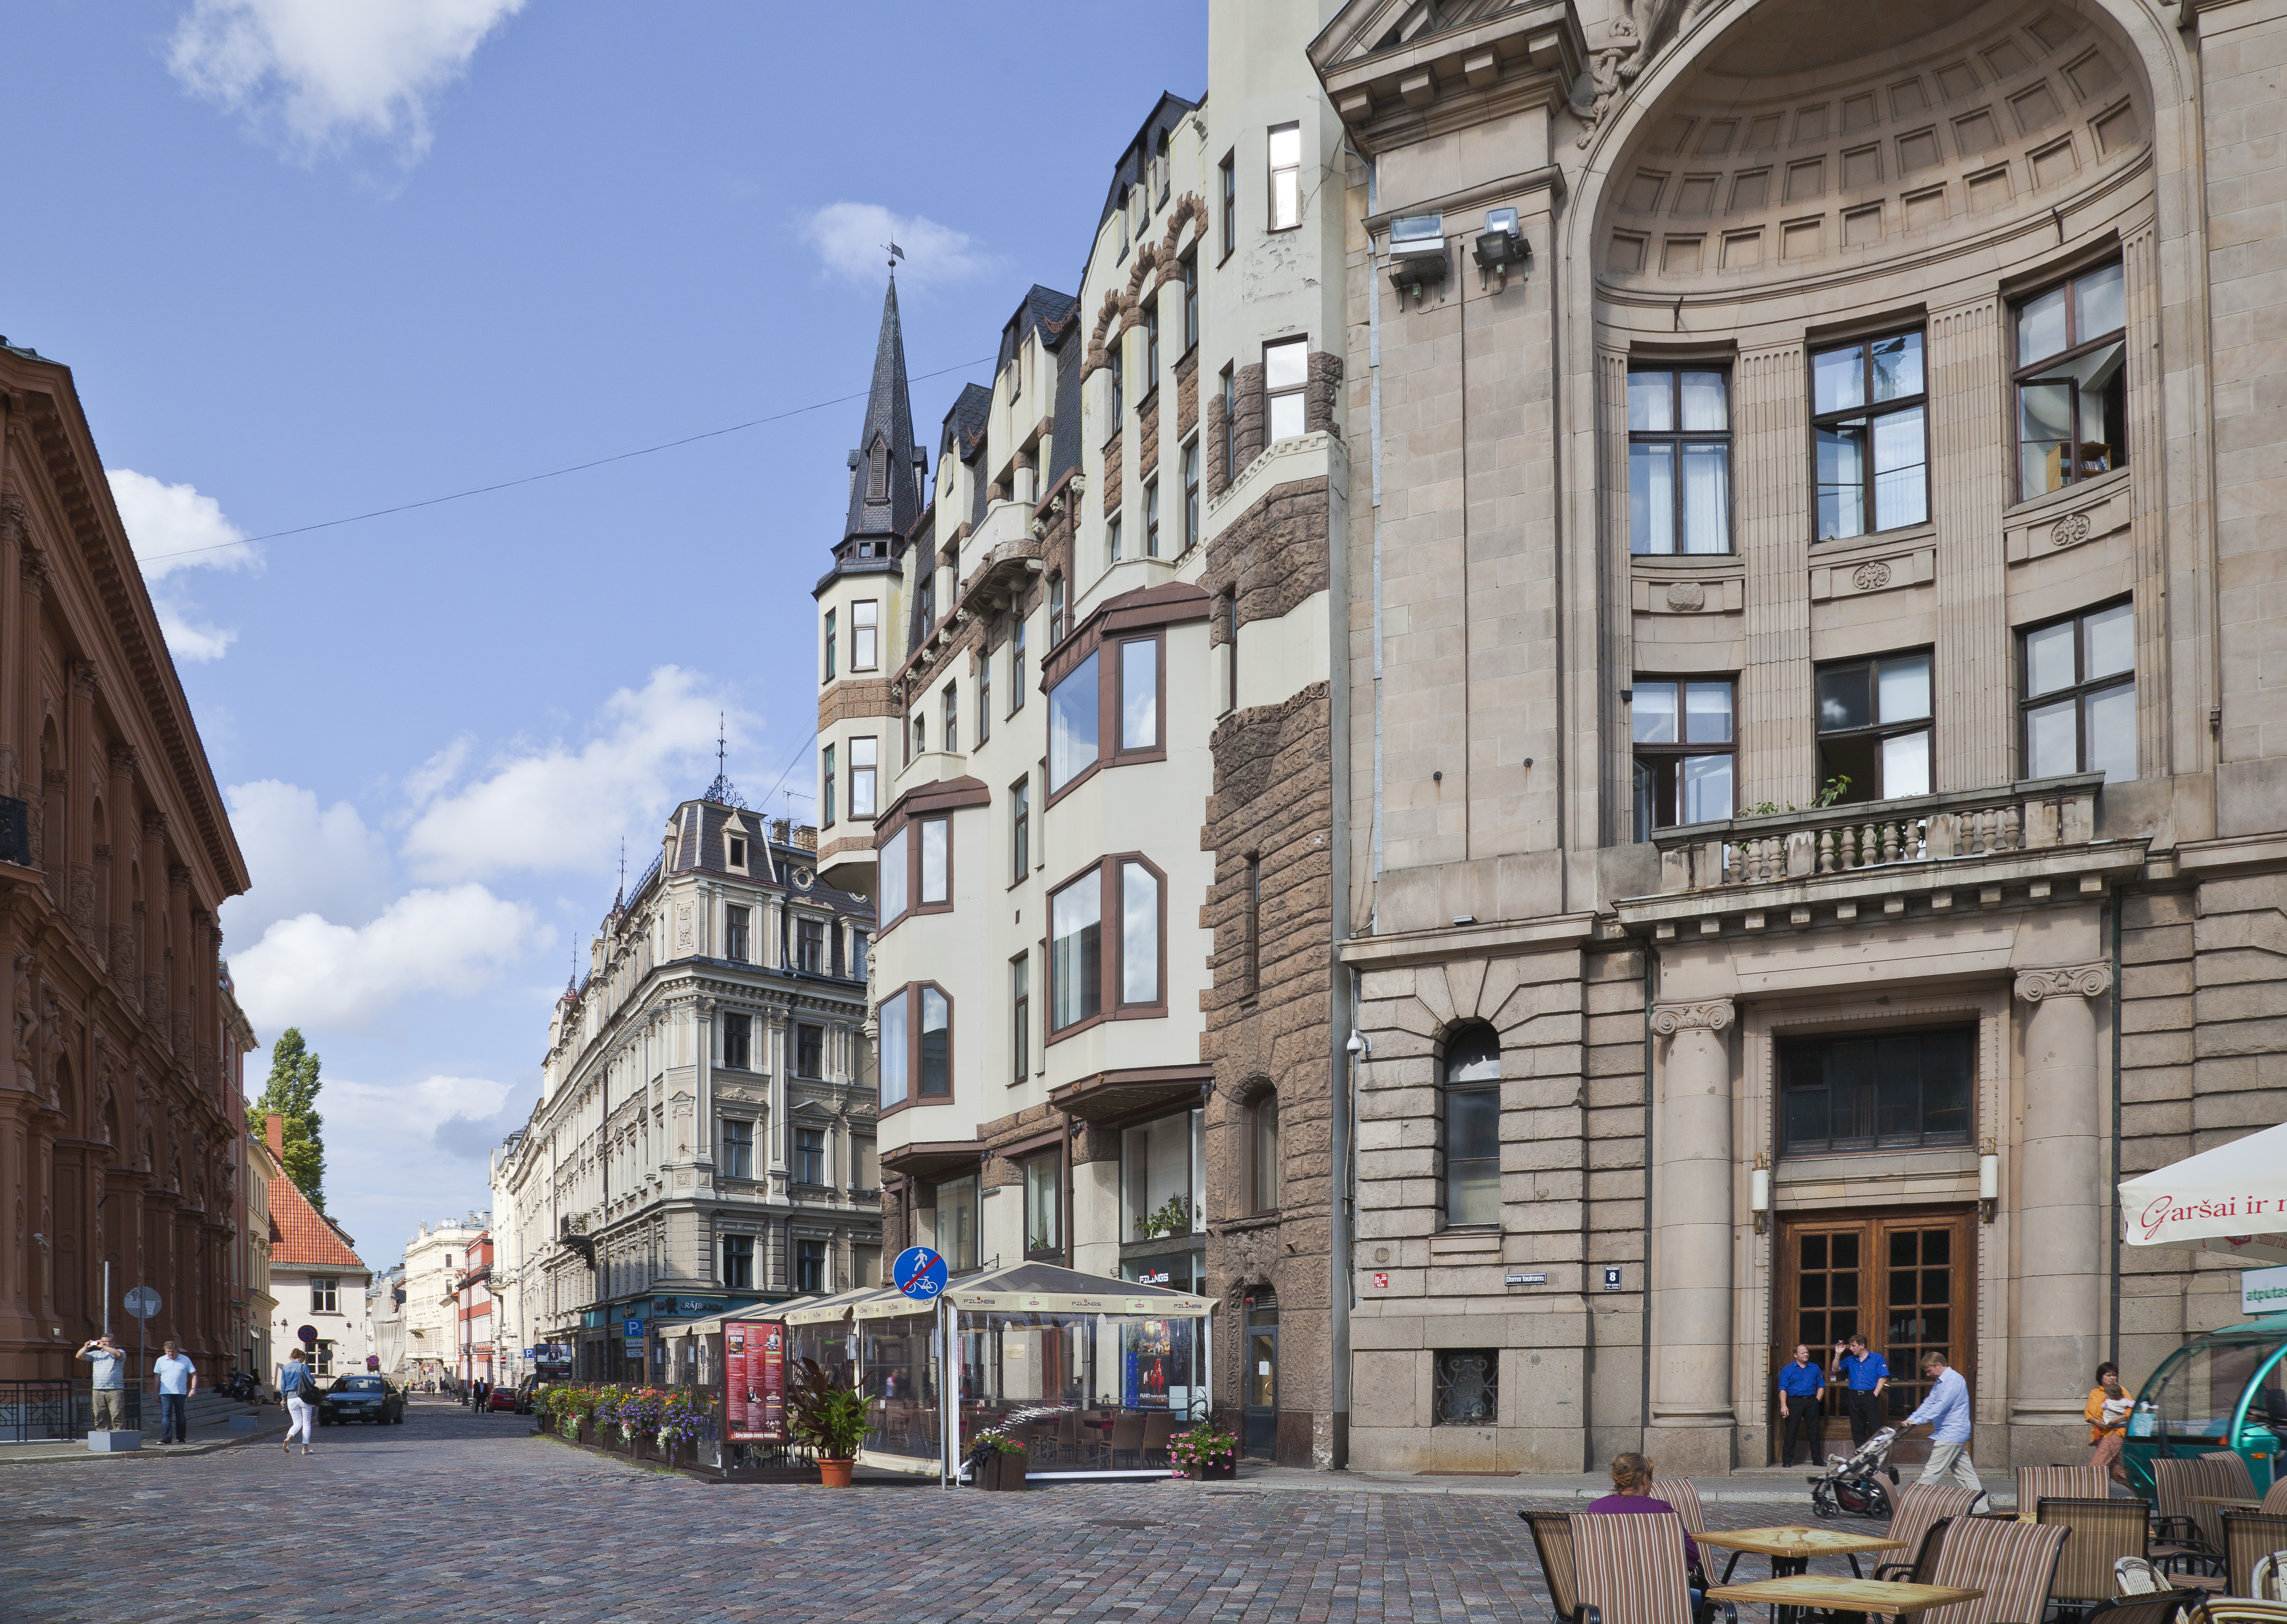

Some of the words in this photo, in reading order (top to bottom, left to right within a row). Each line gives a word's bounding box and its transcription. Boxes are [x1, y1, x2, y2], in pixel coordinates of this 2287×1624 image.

[2141, 1195, 2236, 1240] Garšai
[2245, 1195, 2269, 1214] ir
[1139, 1270, 1169, 1284] FILINGS
[1609, 1272, 1616, 1281] 8
[628, 1321, 639, 1335] P
[526, 1349, 533, 1358] P
